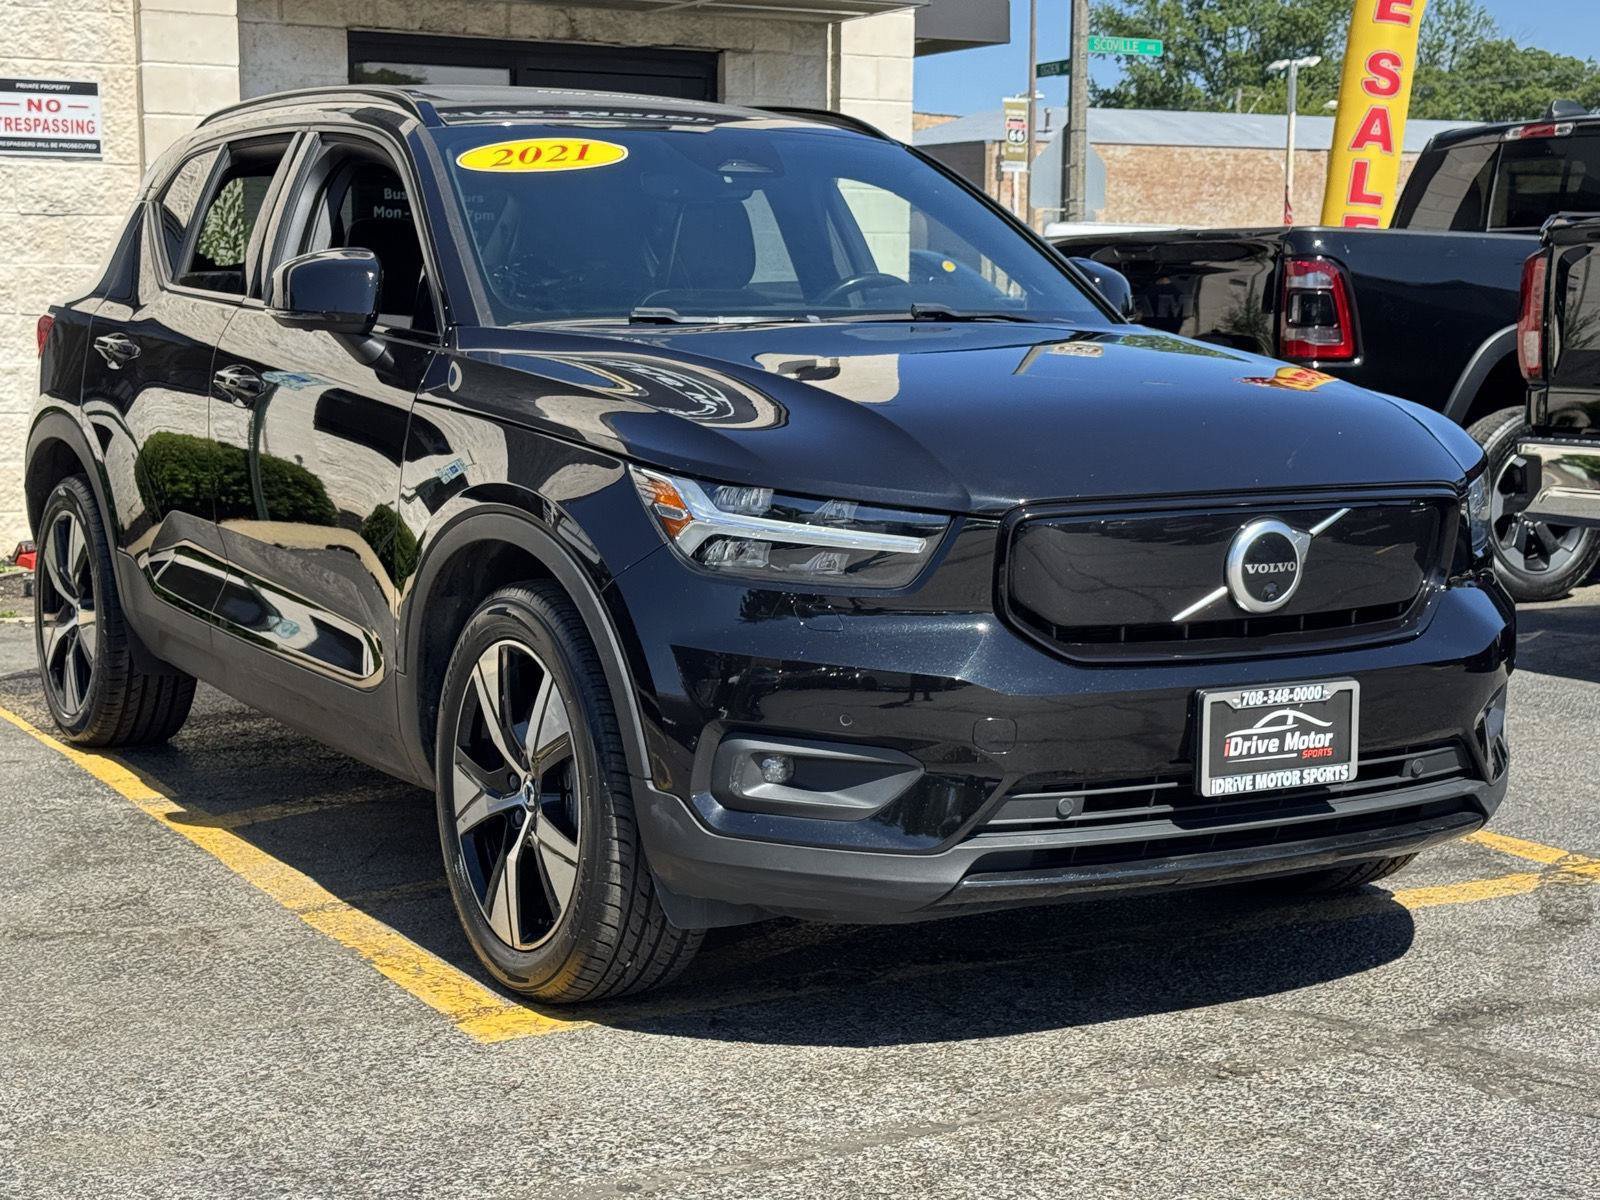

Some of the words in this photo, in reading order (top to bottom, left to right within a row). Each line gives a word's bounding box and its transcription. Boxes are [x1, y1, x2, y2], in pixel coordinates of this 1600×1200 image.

[1094, 38, 1139, 52] SCOVILLE
[16, 82, 39, 90] PRIVATE
[40, 83, 71, 91] PROPERTY
[27, 98, 62, 113] NO
[1008, 128, 1025, 142] 66
[492, 144, 590, 167] 2021
[373, 205, 402, 219] Mon
[1244, 561, 1296, 575] VOLVO
[1241, 685, 1322, 706] 708-348-0000
[1223, 736, 1280, 758] iDrive
[1284, 731, 1334, 751] Motor
[1301, 747, 1333, 759] SPORTS
[1211, 775, 1253, 795] IDRIVE
[1255, 770, 1301, 791] MOTOR
[1303, 765, 1349, 785] SPORTS
